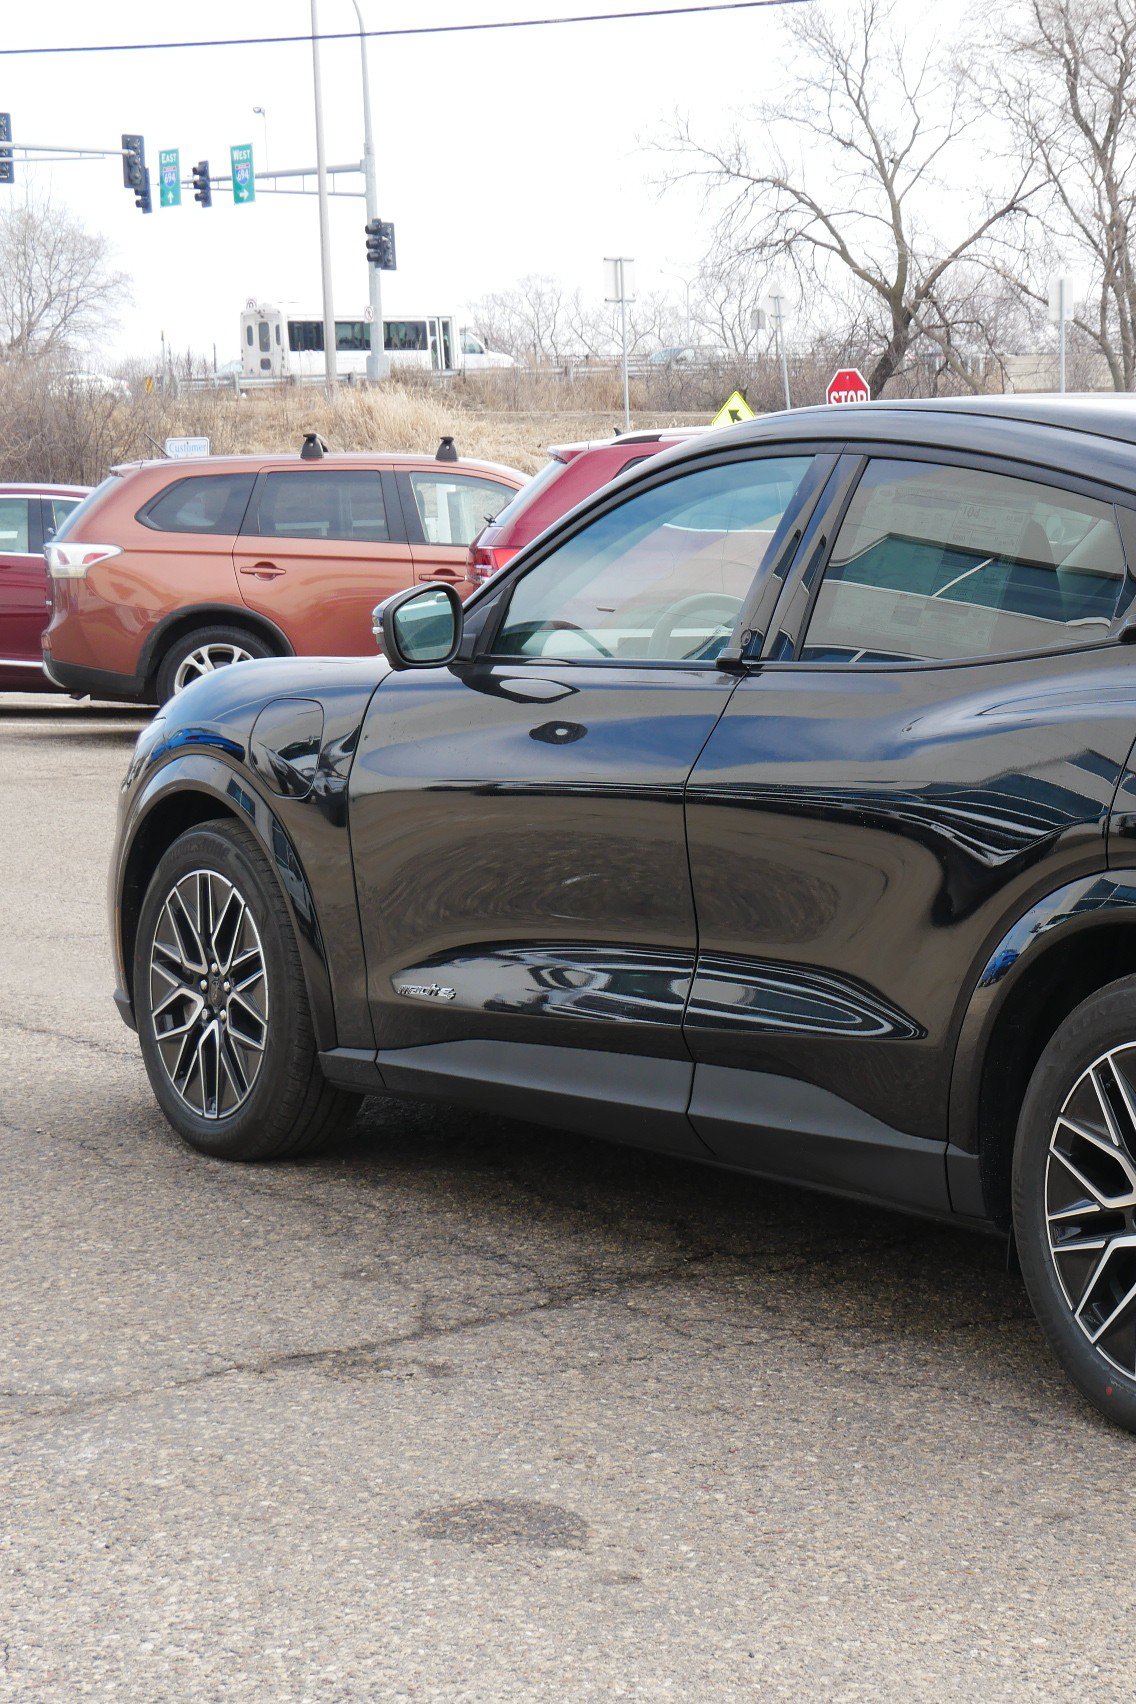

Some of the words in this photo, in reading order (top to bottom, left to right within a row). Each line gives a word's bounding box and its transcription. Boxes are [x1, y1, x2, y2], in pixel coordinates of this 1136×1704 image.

[161, 153, 177, 164] EAST
[233, 149, 250, 161] WEST
[164, 170, 176, 184] 694
[236, 169, 249, 182] 694
[830, 390, 867, 404] STOP
[169, 441, 206, 453] Customer
